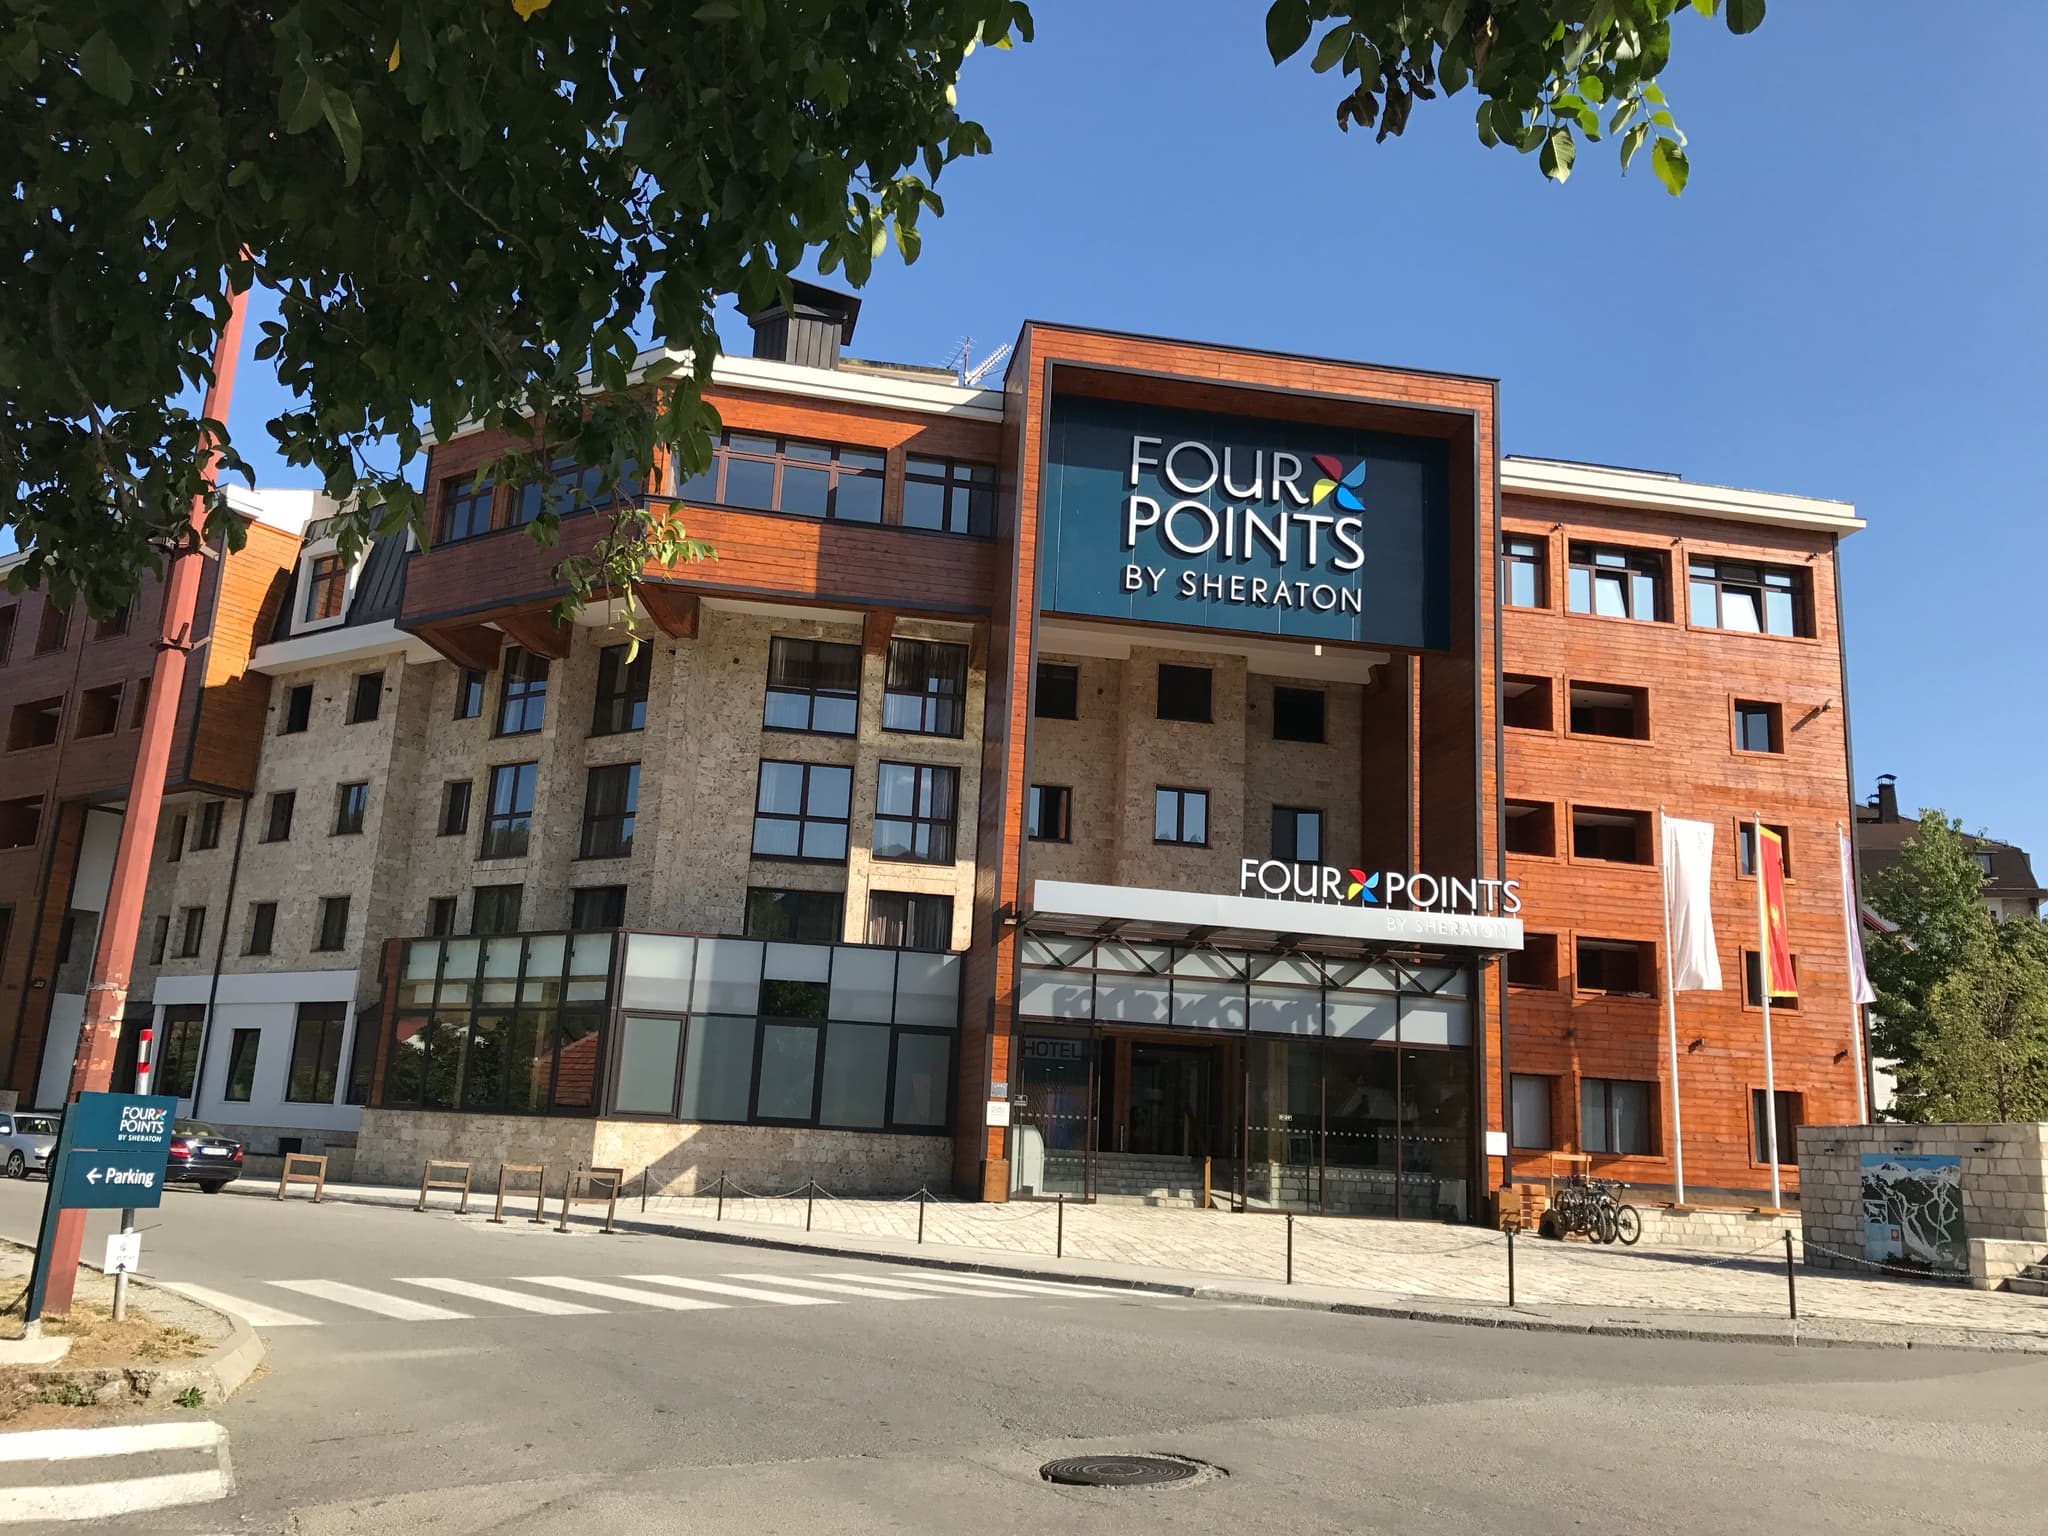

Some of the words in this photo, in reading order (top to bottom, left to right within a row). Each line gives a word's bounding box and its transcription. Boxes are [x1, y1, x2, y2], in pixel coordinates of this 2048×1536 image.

[1130, 435, 1310, 505] FOUR
[1128, 495, 1365, 570] POINTS
[1125, 564, 1166, 592] BY
[1181, 570, 1362, 613] SHERATON
[1240, 858, 1345, 900] FOUR
[1386, 871, 1521, 913] POINTS
[1386, 916, 1406, 932] BY
[1415, 919, 1508, 938] SHERATON
[1023, 1040, 1080, 1058] HOTEL
[122, 1106, 156, 1120] FOUR
[120, 1119, 164, 1134] POINTS
[118, 1134, 127, 1142] BY
[128, 1134, 162, 1143] SHERATON
[105, 1167, 155, 1188] Parking
